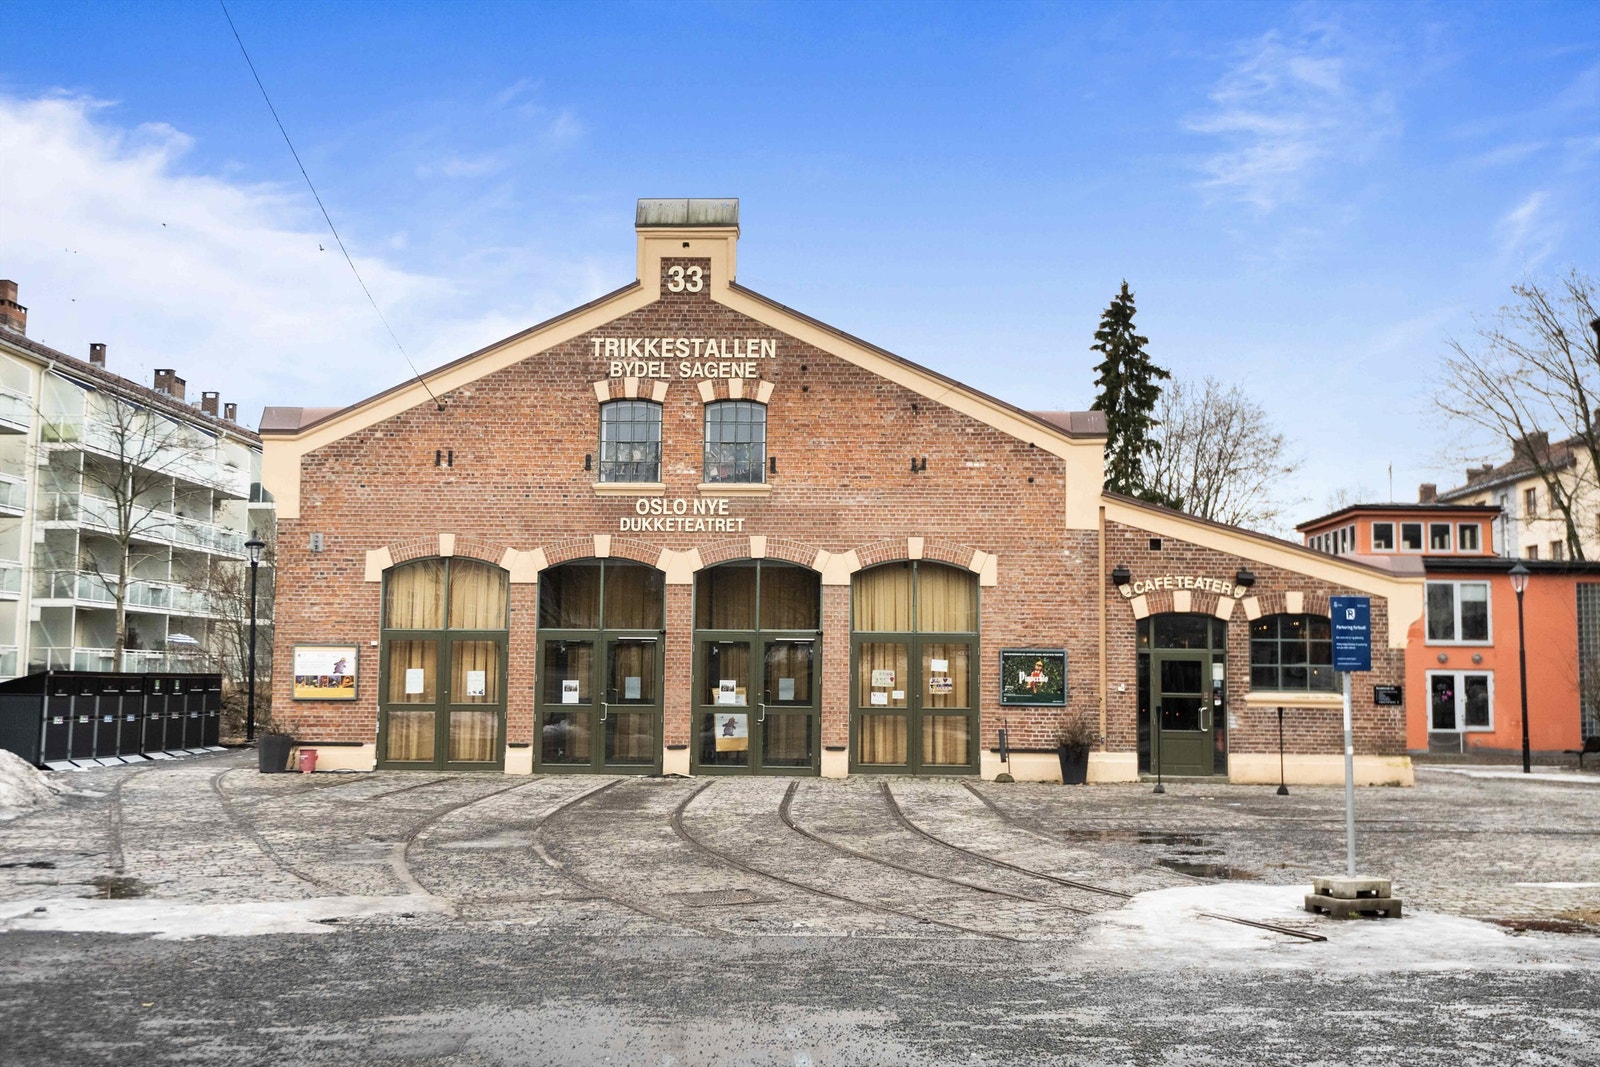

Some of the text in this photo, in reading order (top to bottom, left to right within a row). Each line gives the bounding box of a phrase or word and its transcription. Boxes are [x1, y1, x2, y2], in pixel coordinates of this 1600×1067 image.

[667, 265, 704, 293] 33
[590, 337, 776, 359] TRIKKESTALLEN
[610, 361, 757, 379] BYDEL SAGENE
[635, 498, 729, 515] OSLO NYE
[619, 517, 745, 532] DUKKETEATRET
[1133, 574, 1232, 595] CAFÉ TEATER
